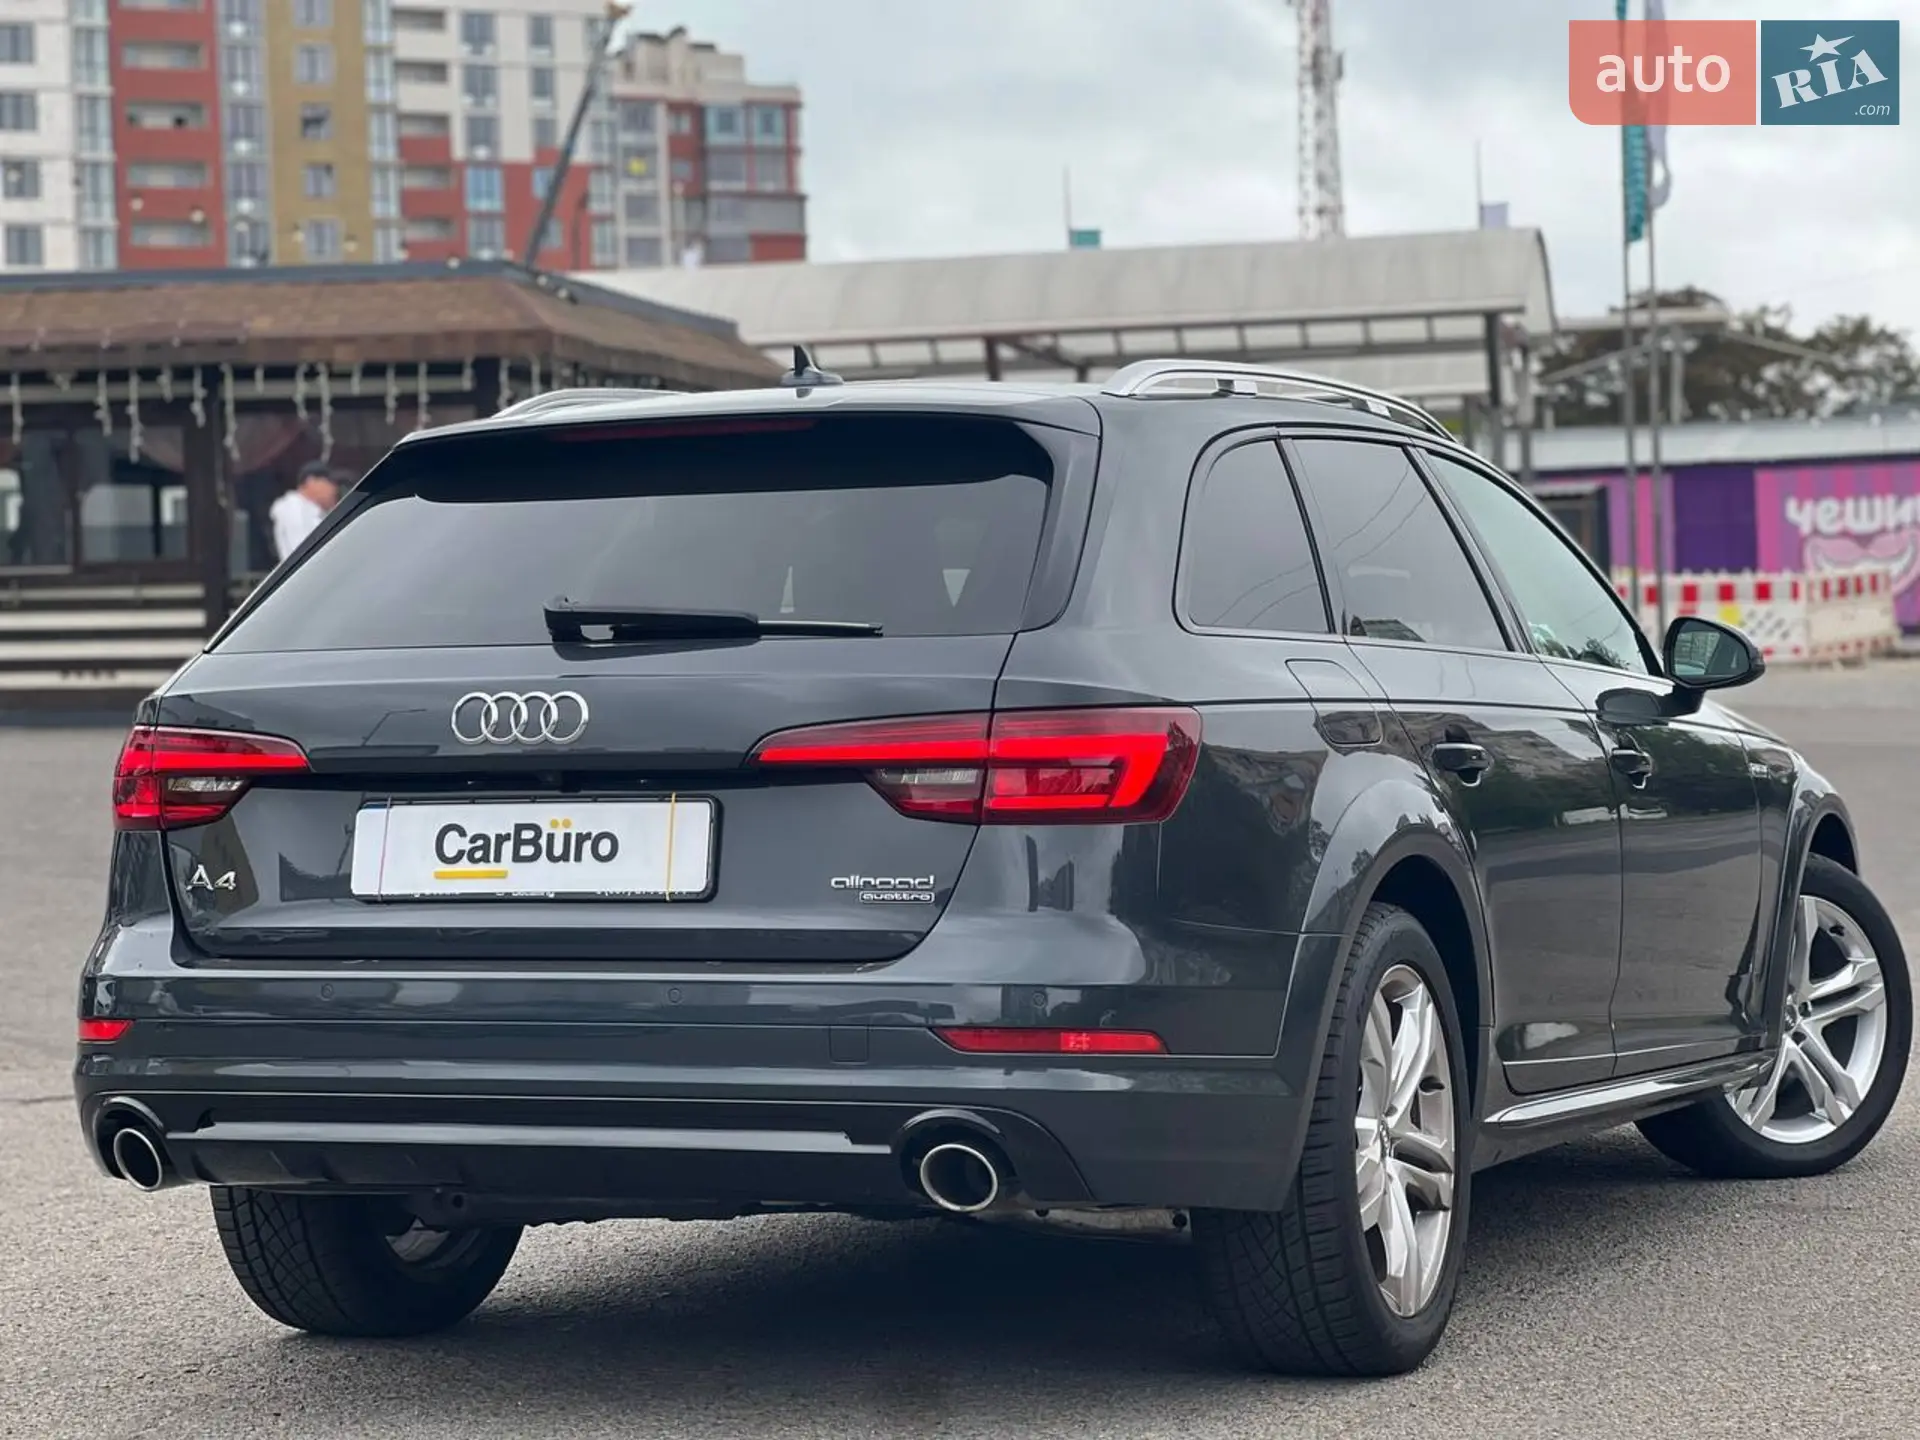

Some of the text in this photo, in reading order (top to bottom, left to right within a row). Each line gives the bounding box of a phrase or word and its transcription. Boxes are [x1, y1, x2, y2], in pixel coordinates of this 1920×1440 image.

[1785, 495, 1920, 535] чеши
[434, 818, 620, 865] CarBüro
[185, 864, 237, 891] A4
[830, 874, 936, 890] allroad
[861, 892, 933, 902] quattro
